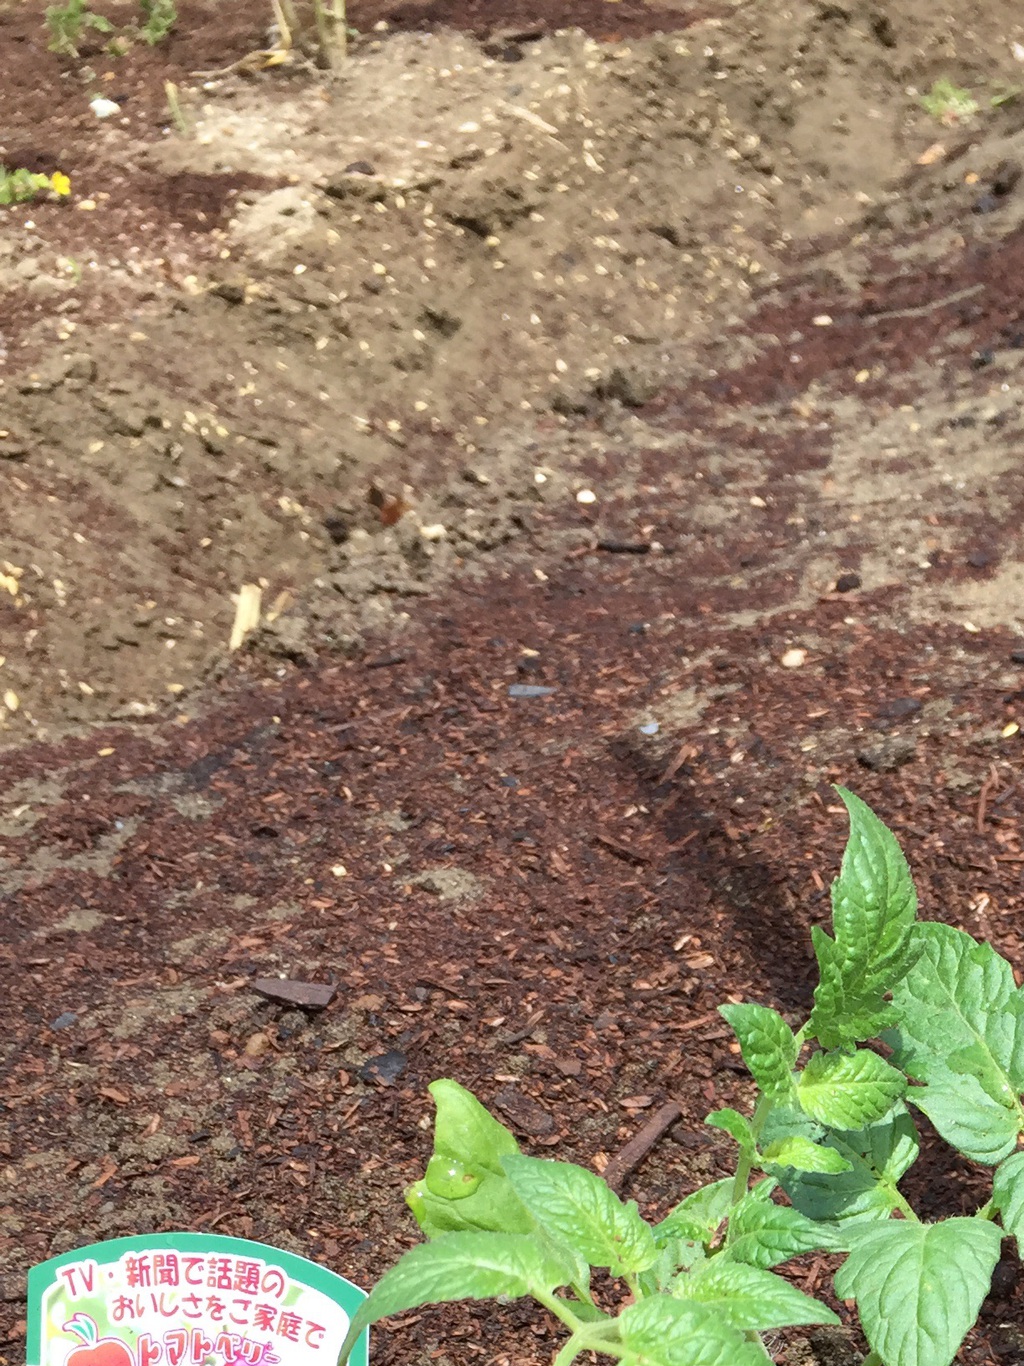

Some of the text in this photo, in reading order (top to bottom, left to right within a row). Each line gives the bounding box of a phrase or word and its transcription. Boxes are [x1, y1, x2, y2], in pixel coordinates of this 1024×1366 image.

[62, 1254, 286, 1300] TV・新聞で話題の
[112, 1292, 327, 1350] おいしさをご家庭で
